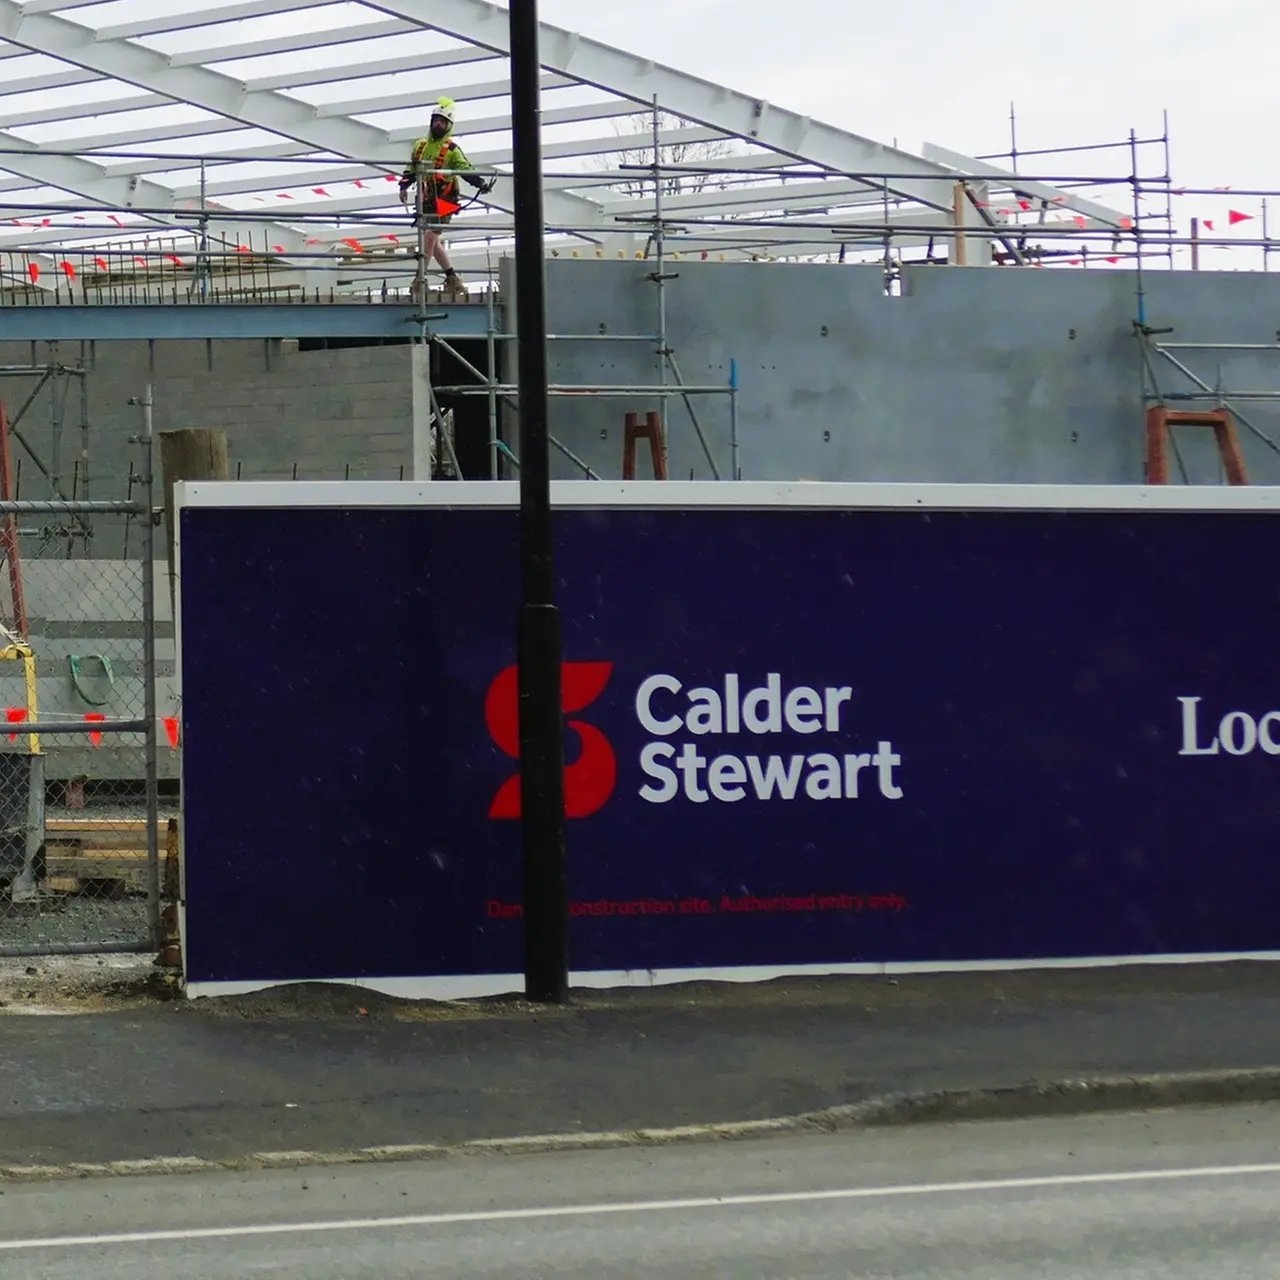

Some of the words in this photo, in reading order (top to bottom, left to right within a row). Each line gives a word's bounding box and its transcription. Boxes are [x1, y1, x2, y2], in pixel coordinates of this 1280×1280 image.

[635, 673, 853, 736] Calder
[1176, 696, 1280, 756] Loc
[638, 740, 904, 803] Stewart
[568, 897, 676, 917] onstruction
[720, 892, 816, 912] Authorised
[818, 893, 863, 914] entry
